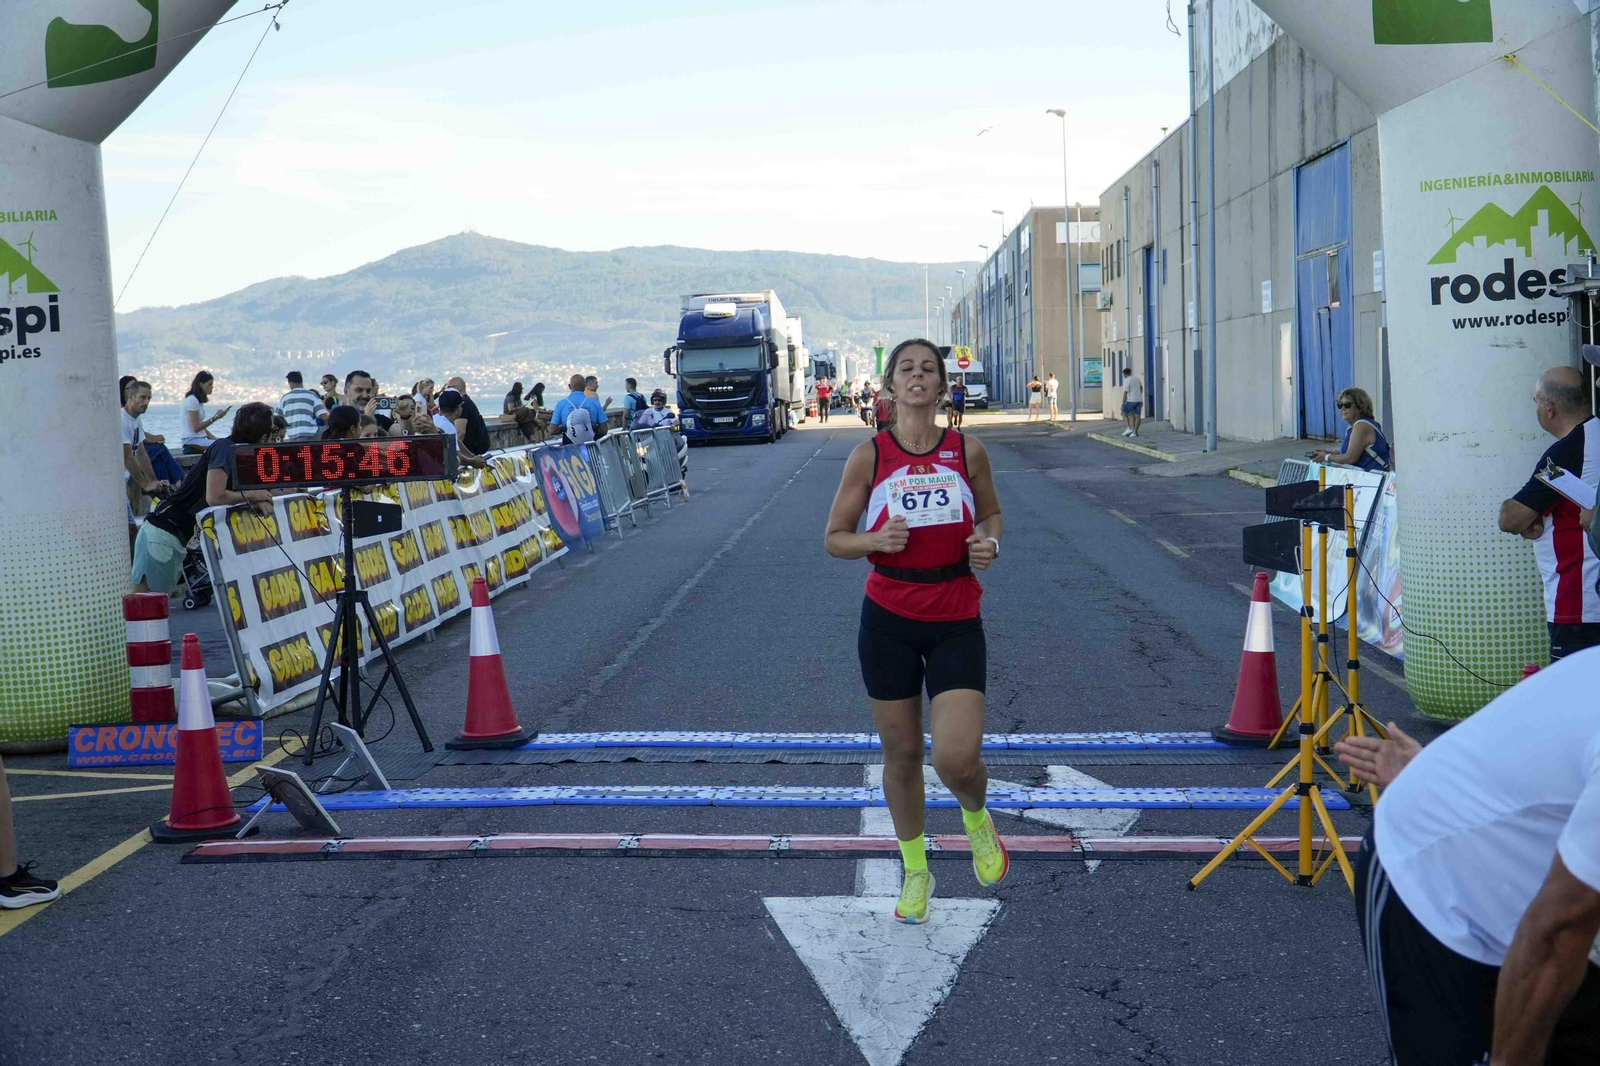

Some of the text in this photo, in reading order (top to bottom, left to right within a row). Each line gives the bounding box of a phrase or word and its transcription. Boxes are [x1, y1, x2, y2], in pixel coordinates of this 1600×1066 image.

[0, 209, 58, 223] BILIARIA
[1430, 257, 1567, 306] rodes
[0, 294, 61, 346] spi
[0, 345, 42, 364] pi.es
[708, 385, 734, 393] IVECO
[256, 440, 410, 483] 0:15:46
[909, 477, 926, 486] POR
[901, 488, 950, 511] 673
[355, 545, 387, 581] GADIS
[258, 569, 300, 612] GADIS
[404, 588, 431, 623] GADIS
[268, 638, 315, 682] GADIS
[74, 721, 257, 752] CRONEC
[76, 749, 256, 765] WWW.CRONC.ES
